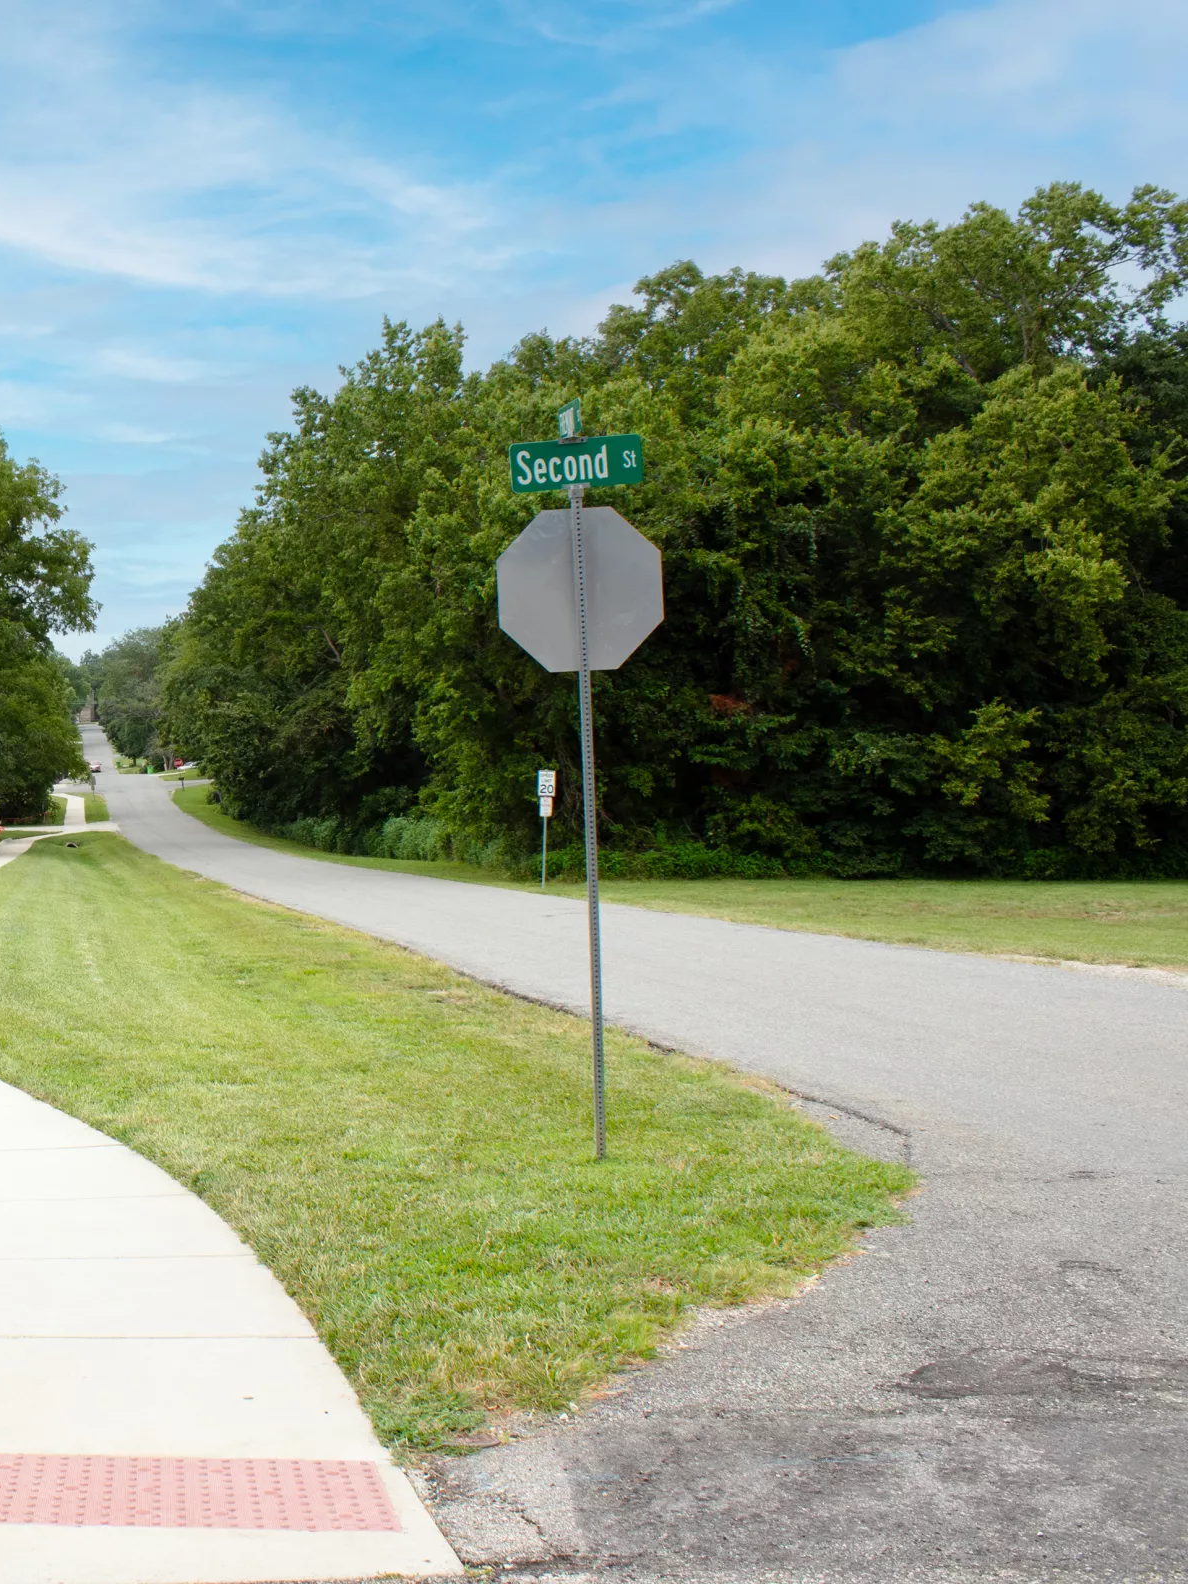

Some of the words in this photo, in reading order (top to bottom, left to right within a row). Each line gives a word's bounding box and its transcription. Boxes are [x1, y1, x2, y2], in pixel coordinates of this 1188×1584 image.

[516, 444, 609, 485] Second
[622, 450, 637, 468] St
[540, 784, 554, 794] 20
